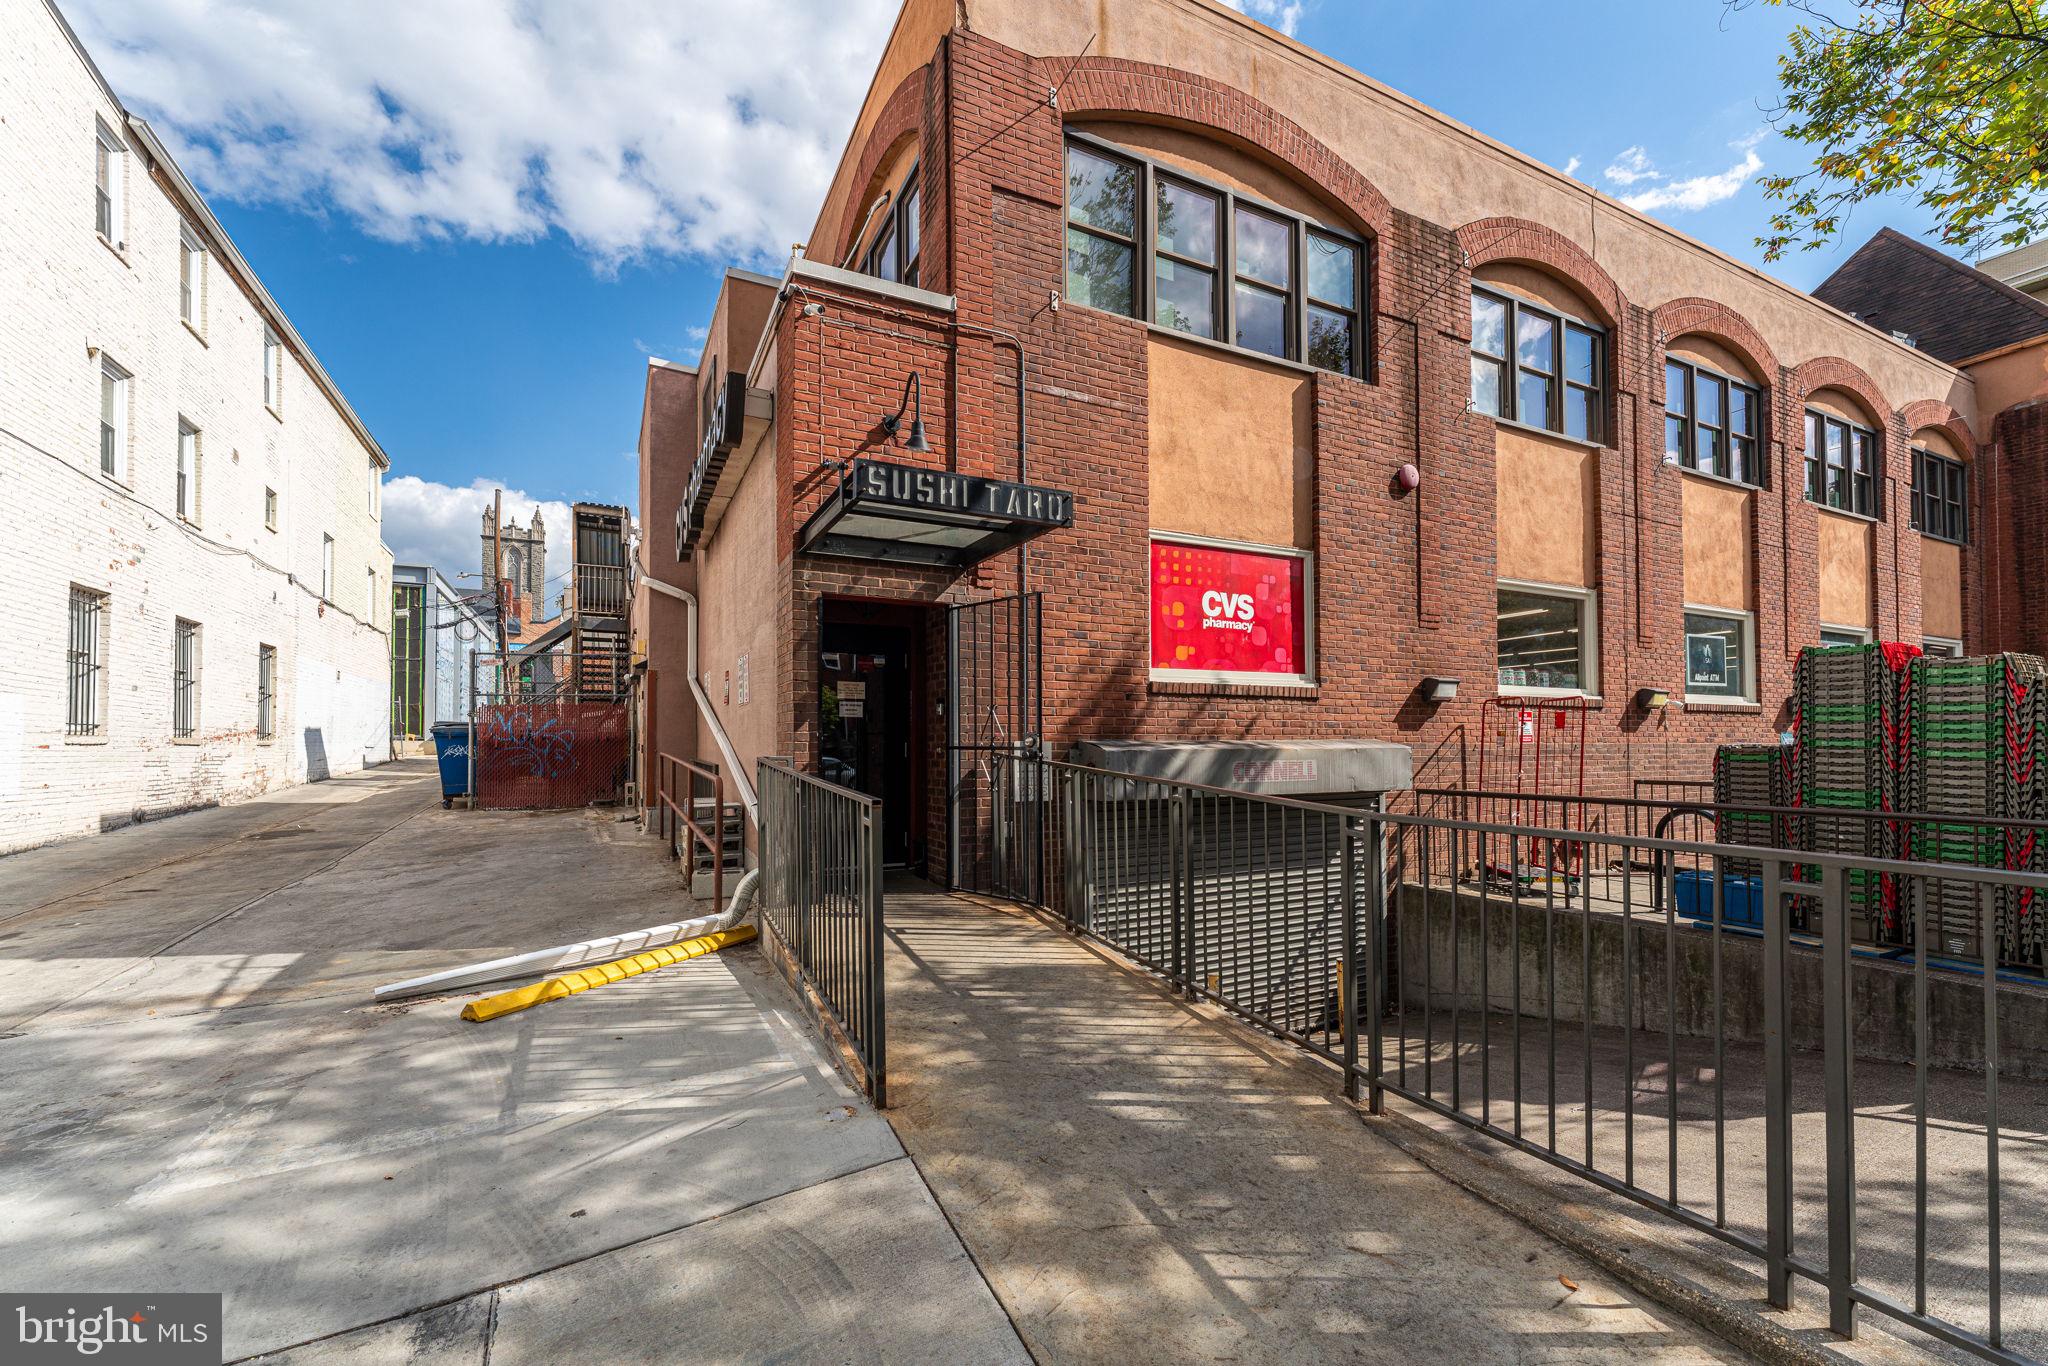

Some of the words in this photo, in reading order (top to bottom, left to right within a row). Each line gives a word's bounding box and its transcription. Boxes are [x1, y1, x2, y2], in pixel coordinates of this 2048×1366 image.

[868, 465, 969, 508] SUSHI
[984, 483, 1064, 521] TARO
[1201, 590, 1255, 620] CVS
[1202, 616, 1254, 633] pharmacy
[1233, 761, 1317, 782] CORNELL
